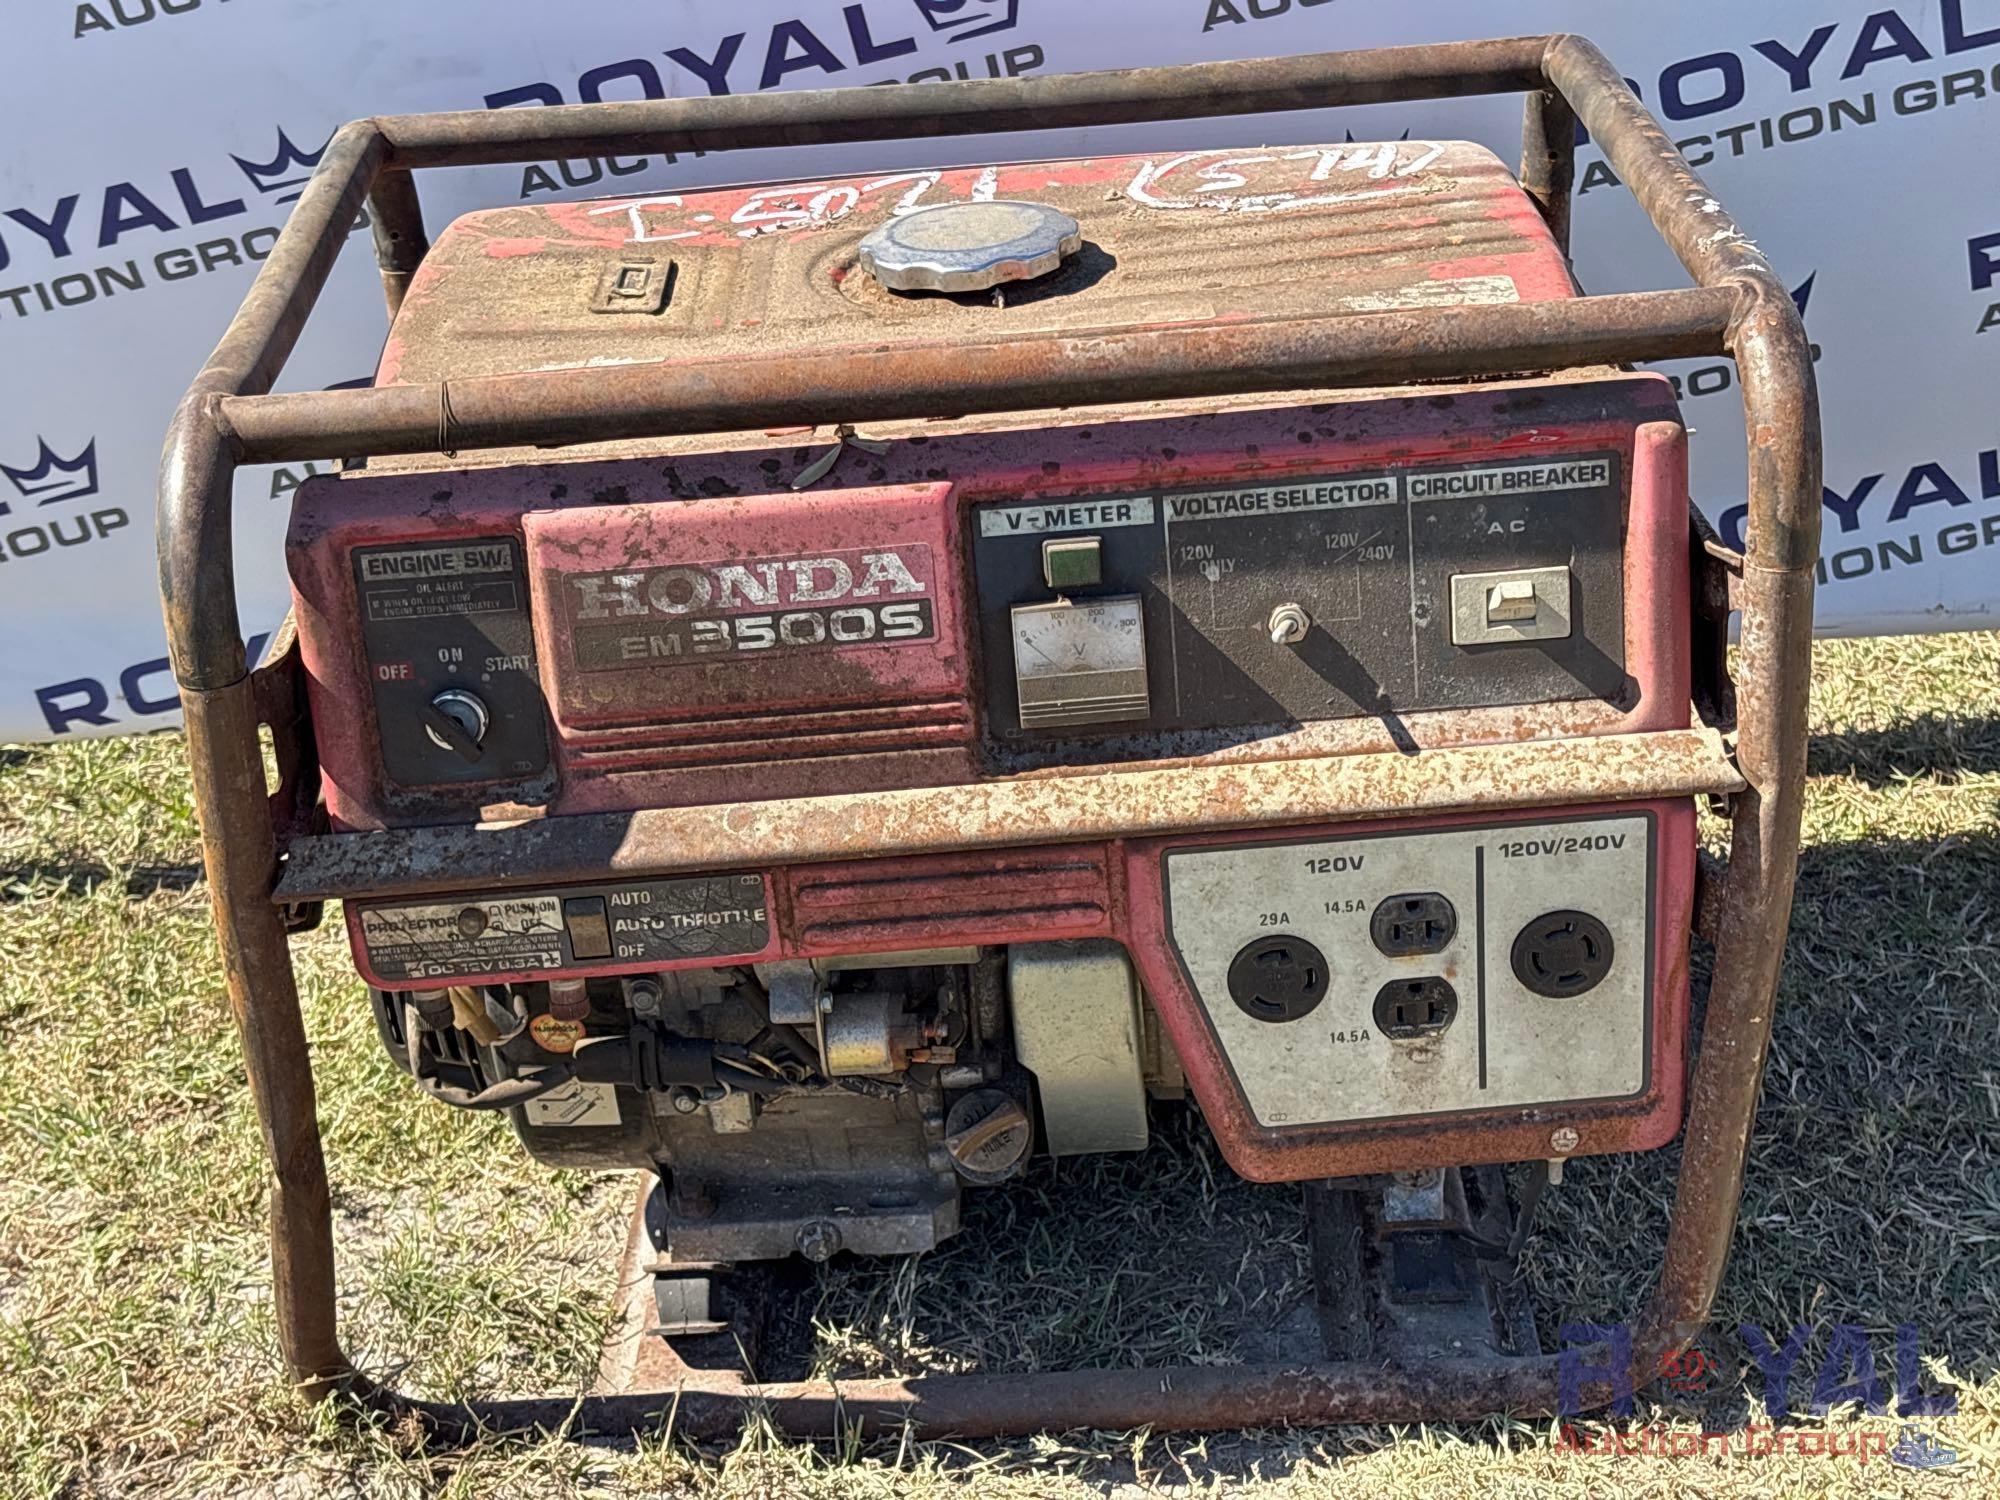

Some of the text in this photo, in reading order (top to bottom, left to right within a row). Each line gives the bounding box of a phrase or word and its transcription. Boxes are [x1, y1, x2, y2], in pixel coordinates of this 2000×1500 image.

[1577, 93, 1876, 196] ACTION
[0, 167, 247, 272] YAL
[1411, 464, 1606, 497] CIRCUIT BREAKER
[1171, 482, 1390, 517] VOLTAGE SELECTOR
[0, 507, 130, 563] OUP
[1325, 532, 1360, 549] 120V
[1180, 545, 1215, 561] 120V
[1357, 545, 1395, 562] 240V
[368, 550, 509, 576] ENGINE SW.
[573, 552, 926, 620] HONDA
[620, 603, 924, 660] EM 3500S
[1119, 618, 1137, 627] 300
[379, 664, 408, 681] OFF
[485, 654, 530, 672] START
[1498, 833, 1627, 859] 120V/240V
[1304, 855, 1365, 876] 120V
[611, 890, 651, 907] AUTO
[1323, 899, 1367, 915] 14.5A
[615, 908, 766, 933] AUTO THROTTLE
[1259, 912, 1291, 928] 29A
[618, 943, 646, 958] OFF
[1329, 1029, 1371, 1044] 14.5A
